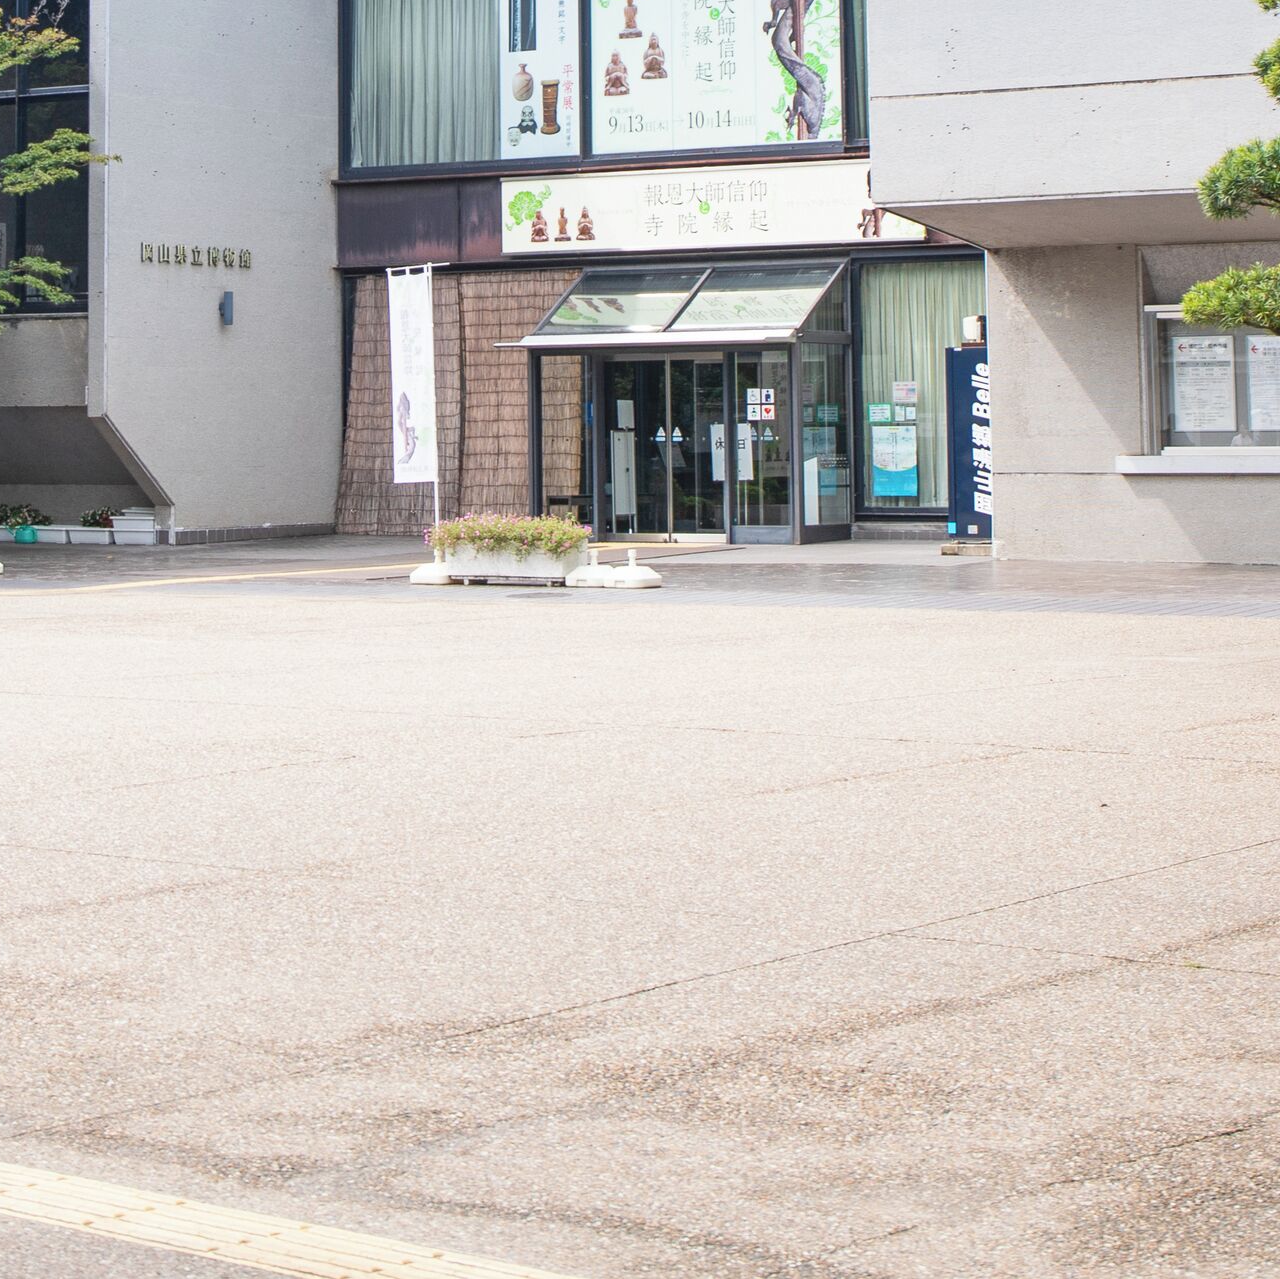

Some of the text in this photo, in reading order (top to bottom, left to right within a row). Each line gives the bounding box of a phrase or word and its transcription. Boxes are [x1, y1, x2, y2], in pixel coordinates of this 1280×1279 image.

[643, 180, 768, 207] 報恩大師信仰
[644, 209, 769, 237] 寺院縁起
[140, 241, 251, 269] 岡山県立博物館
[971, 362, 991, 419] Belle
[715, 436, 746, 450] 休日
